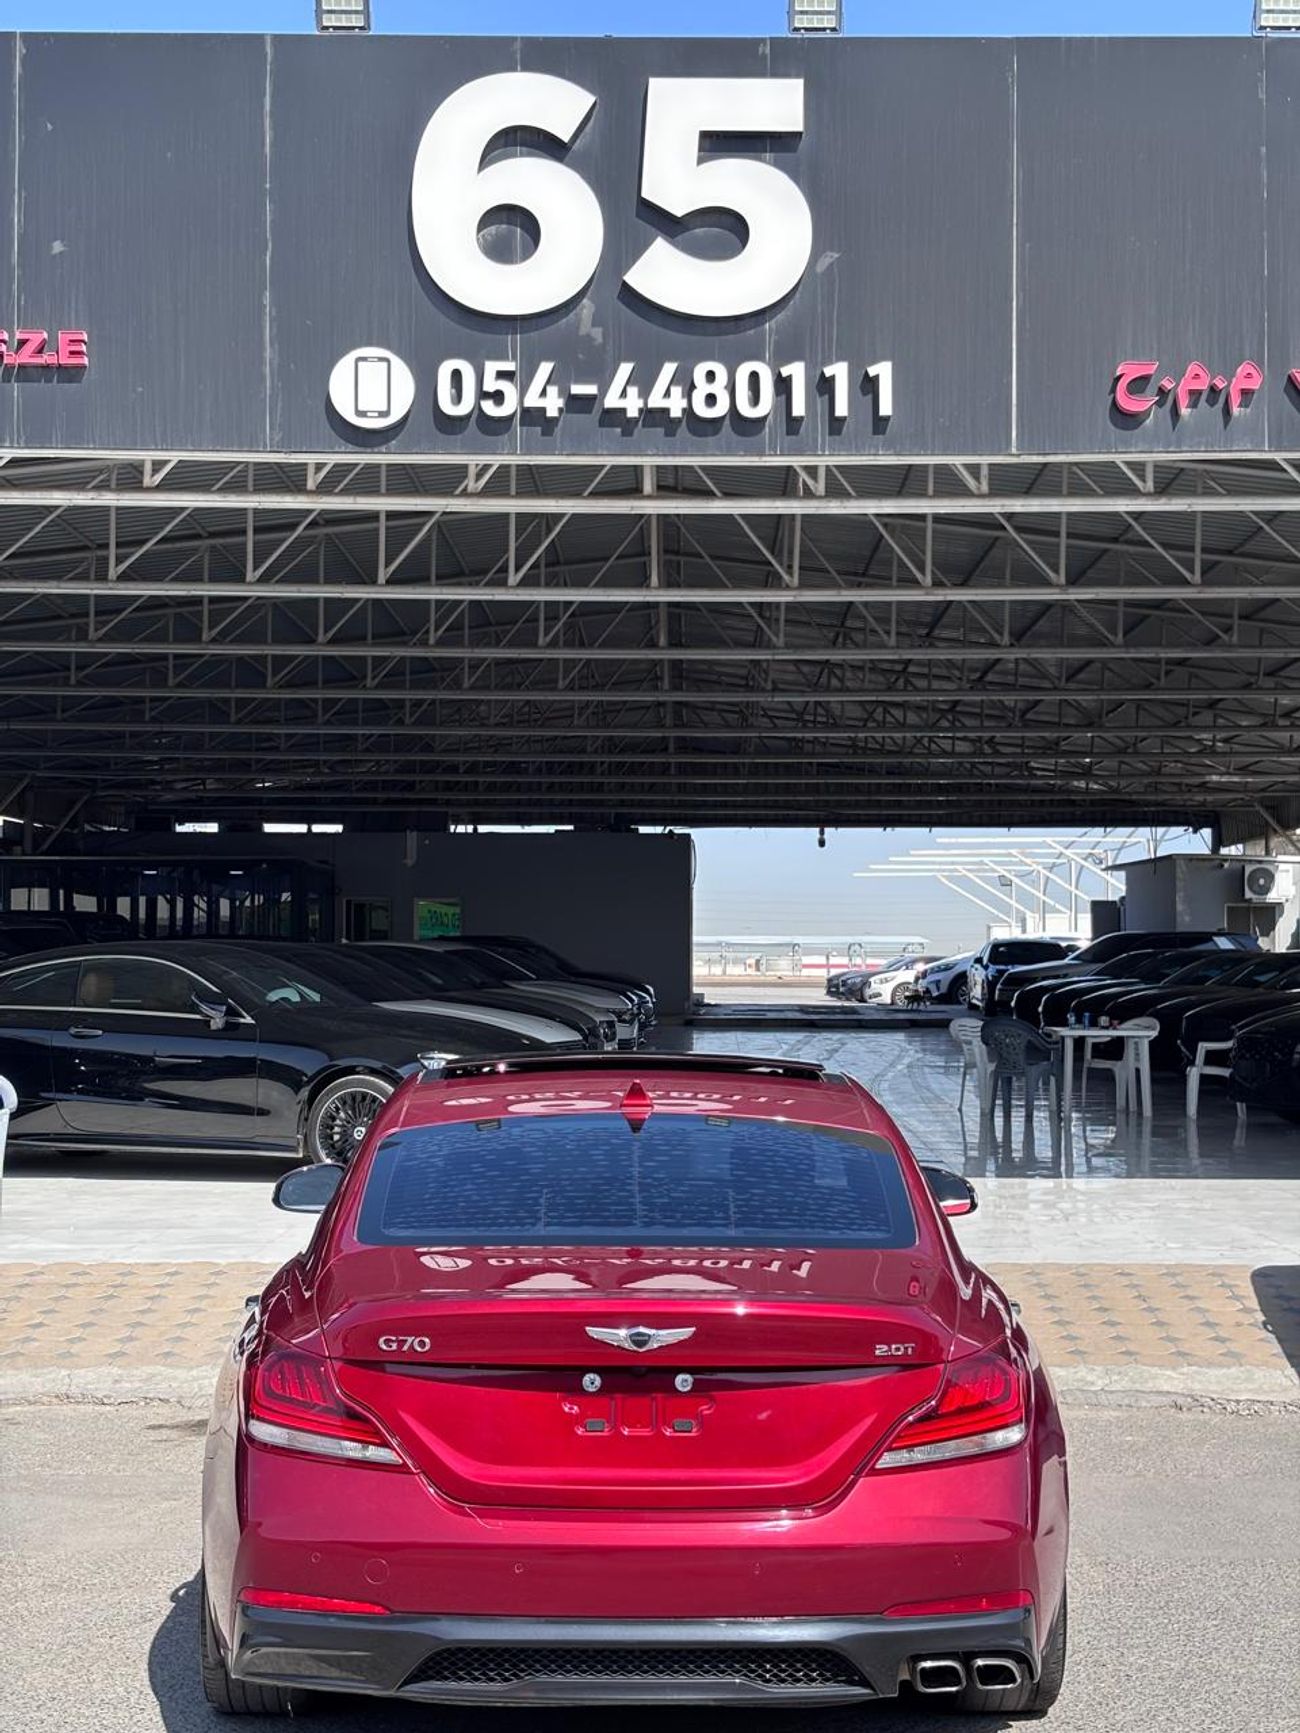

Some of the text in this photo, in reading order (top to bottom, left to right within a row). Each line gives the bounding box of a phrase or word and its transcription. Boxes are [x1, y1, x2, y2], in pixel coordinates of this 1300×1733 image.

[411, 71, 813, 317] 65
[0, 329, 88, 366] .Z.E
[436, 358, 894, 419] 054-4480111
[378, 1335, 431, 1352] G70
[874, 1343, 916, 1356] 2.0T
